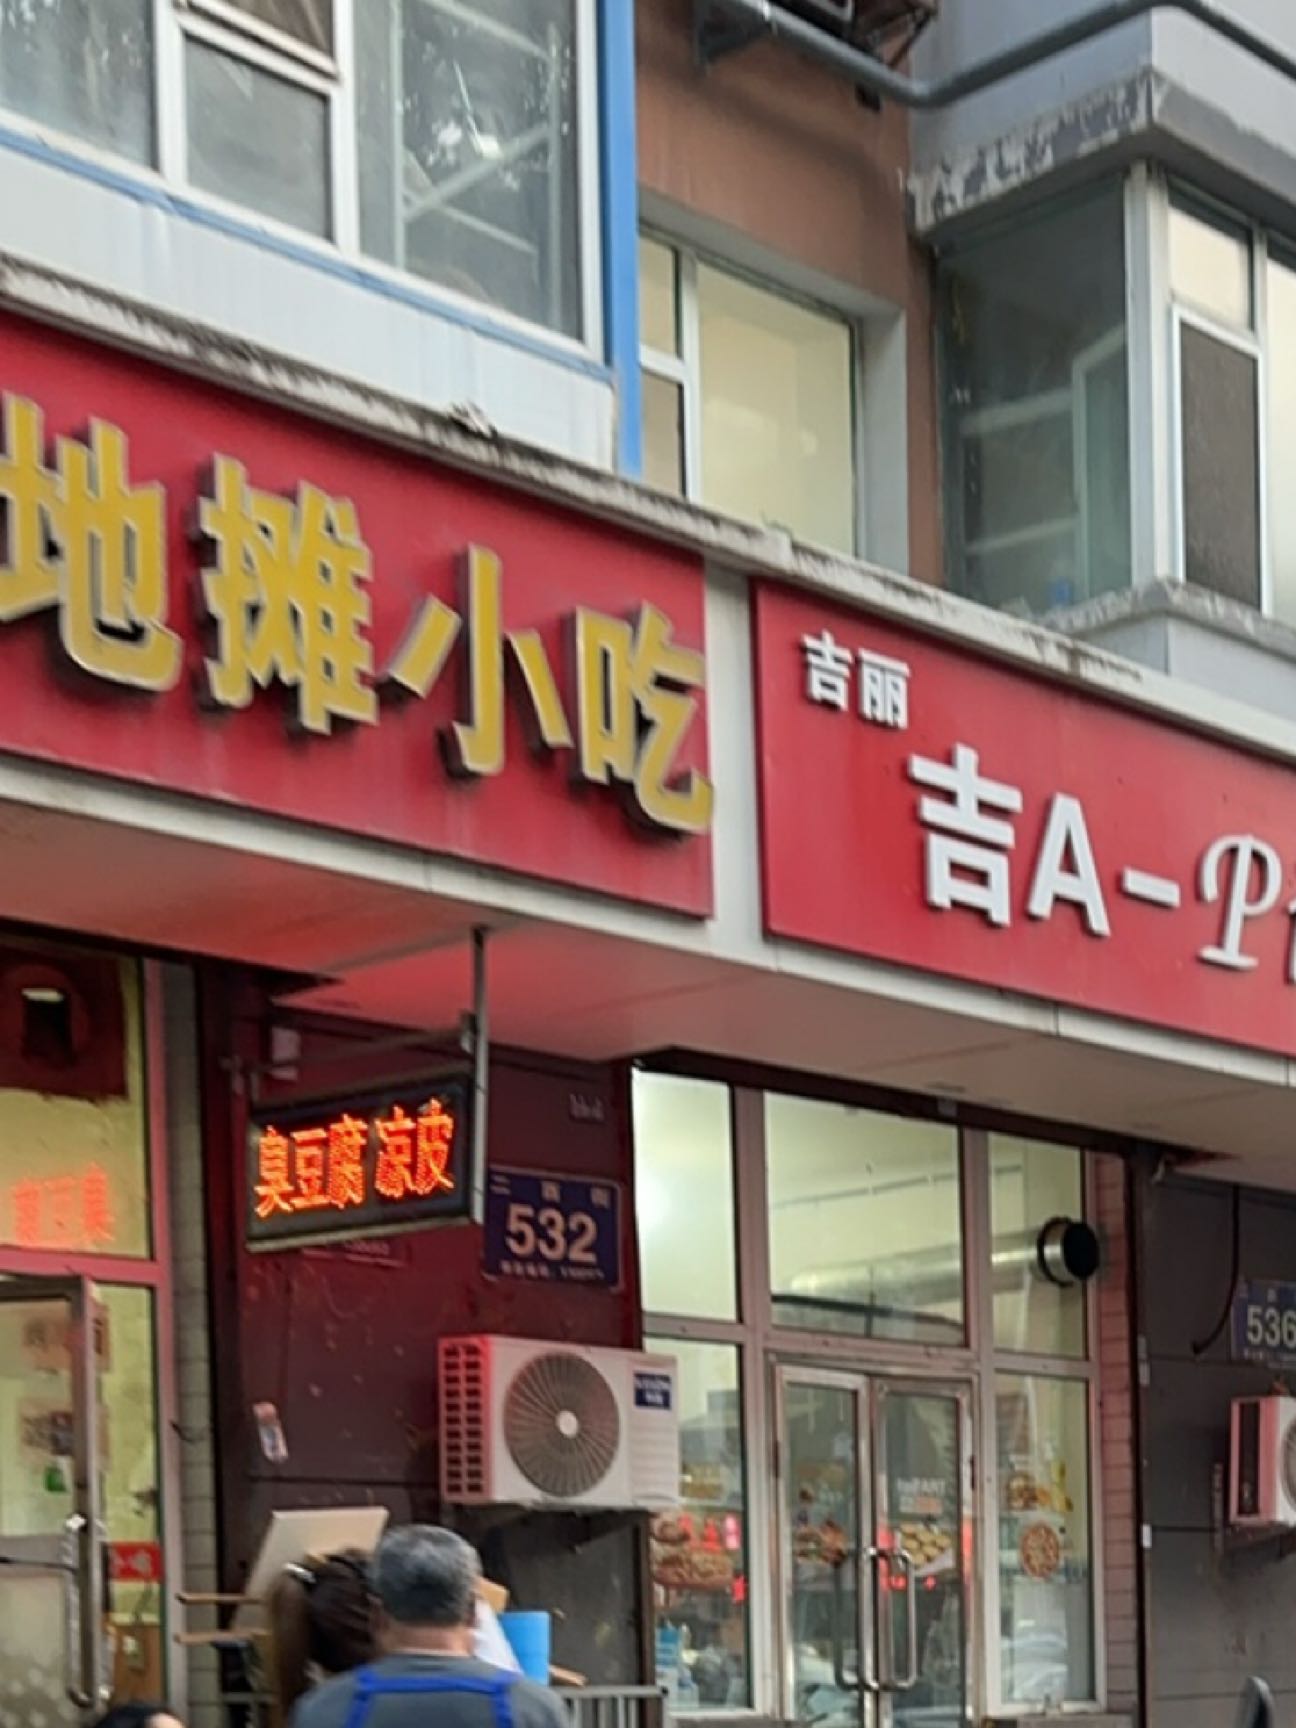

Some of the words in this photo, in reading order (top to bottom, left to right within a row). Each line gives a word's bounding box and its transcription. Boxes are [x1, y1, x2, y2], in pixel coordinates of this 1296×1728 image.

[0, 390, 714, 834] 地摊小吃
[801, 628, 910, 730] 吉丽
[254, 1112, 368, 1218] 臭豆腐
[504, 1201, 598, 1264] 532
